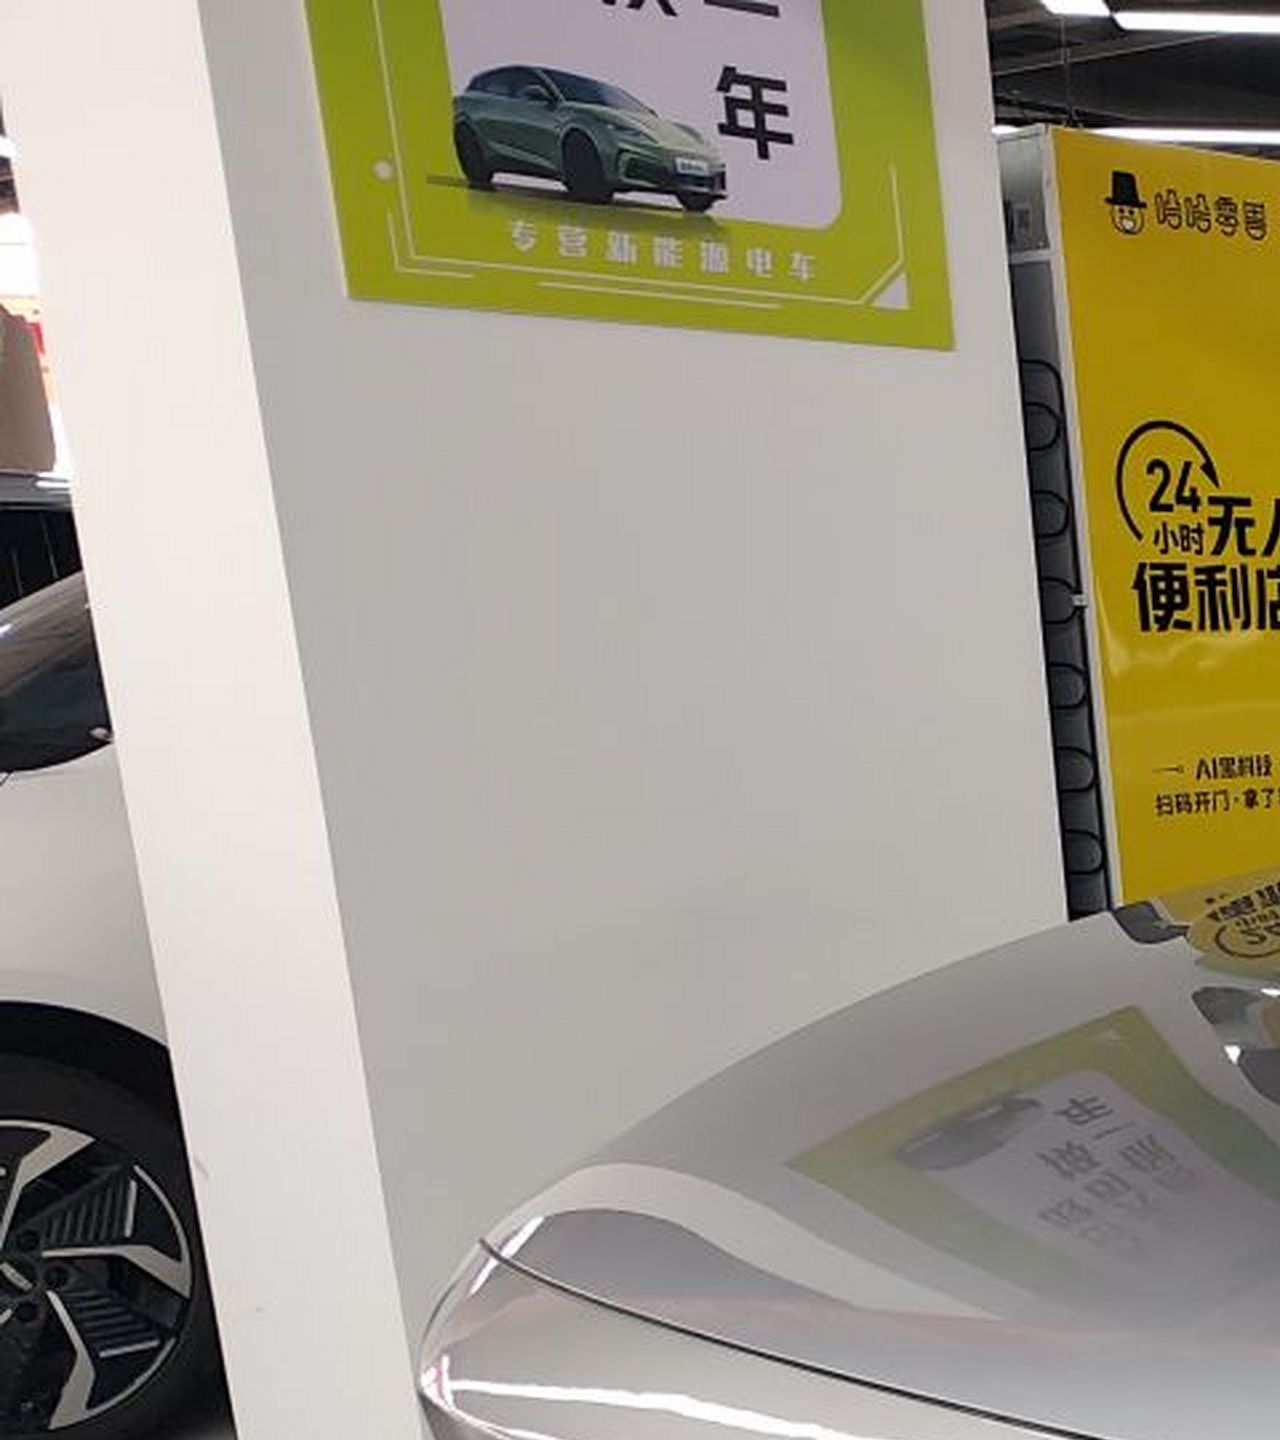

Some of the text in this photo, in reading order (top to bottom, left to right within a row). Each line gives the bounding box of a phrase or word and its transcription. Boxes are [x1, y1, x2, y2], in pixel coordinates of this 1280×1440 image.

[1146, 458, 1201, 513] 24
[1152, 520, 1205, 555] 小时
[1196, 754, 1272, 780] AI黑科技
